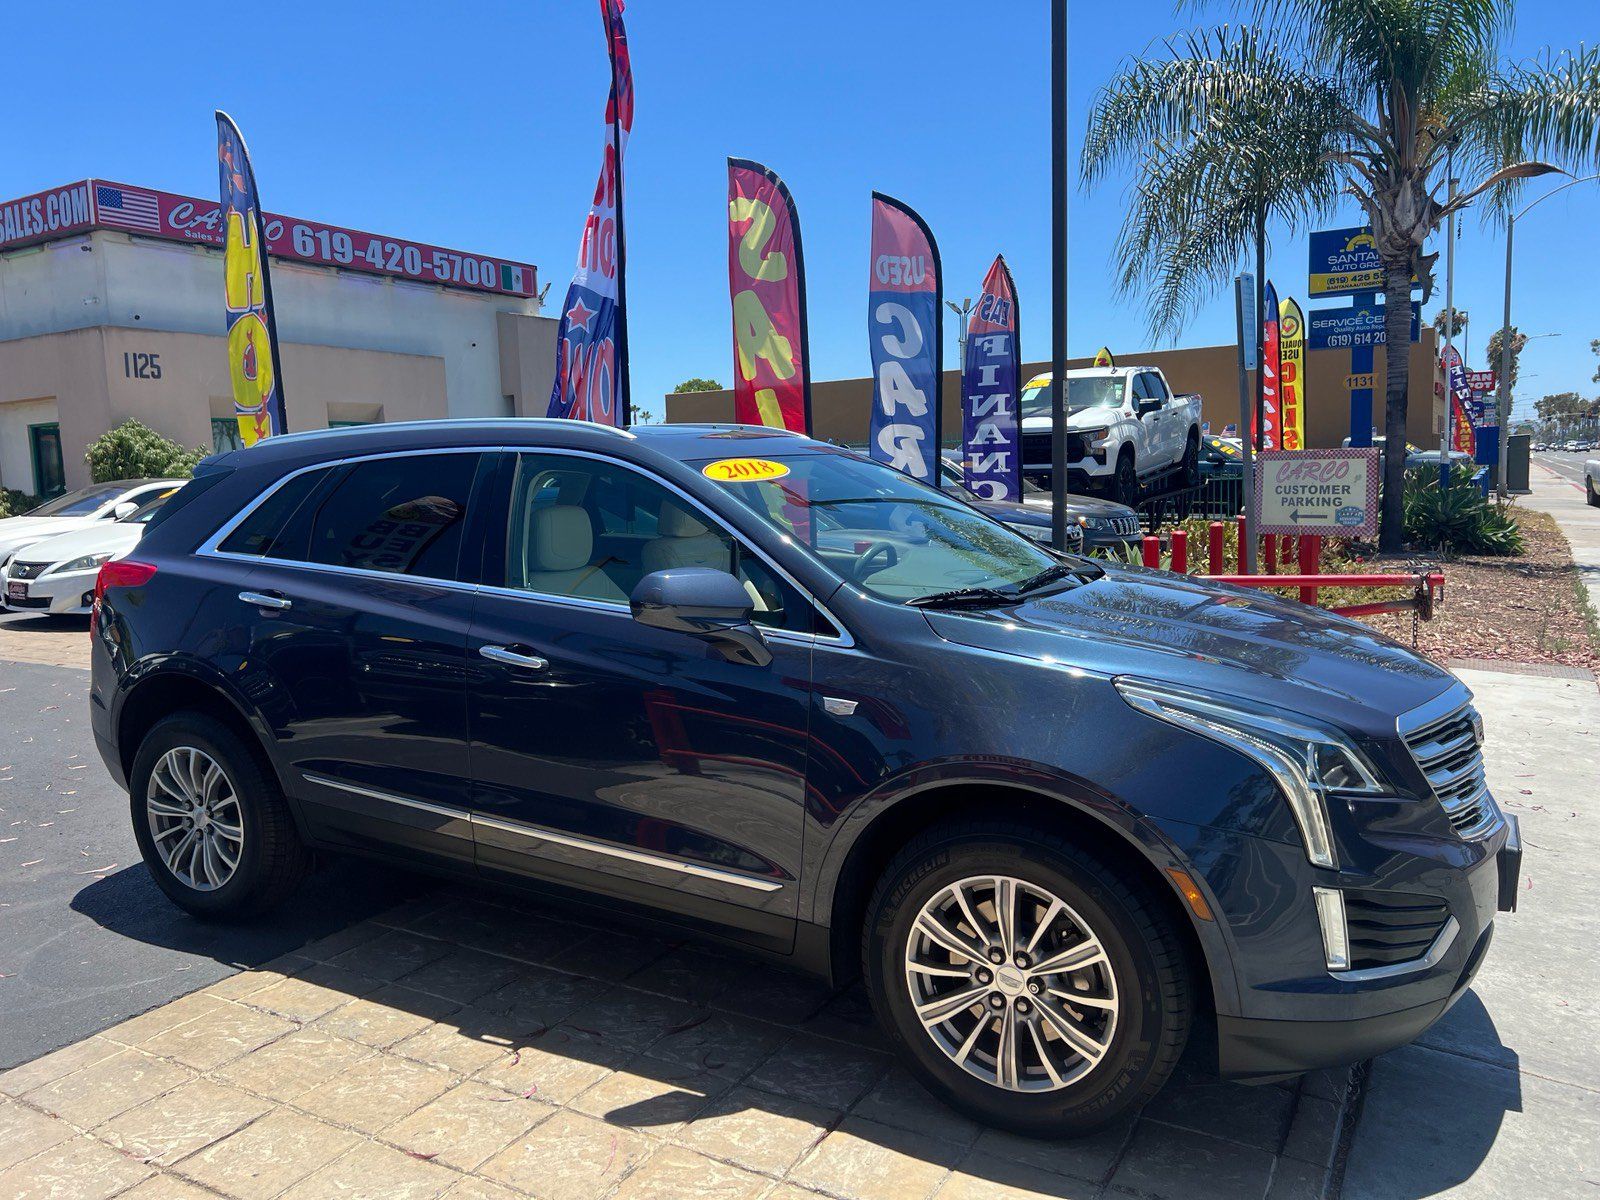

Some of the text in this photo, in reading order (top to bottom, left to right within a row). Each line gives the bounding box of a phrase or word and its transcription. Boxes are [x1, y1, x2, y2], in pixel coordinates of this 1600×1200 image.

[168, 201, 285, 241] CAO
[184, 229, 213, 241] Sales
[292, 224, 496, 288] 619-420-5700
[1330, 263, 1358, 273] AUTO
[1312, 317, 1363, 328] SERVICE
[1327, 333, 1352, 347] (619)
[1354, 332, 1371, 344] 614
[124, 352, 161, 379] 1125
[1346, 376, 1373, 387] 1131
[719, 461, 775, 479] 2018
[1275, 461, 1349, 482] CARCO
[1275, 485, 1351, 495] CUSTOMER
[1281, 497, 1343, 507] PARKING
